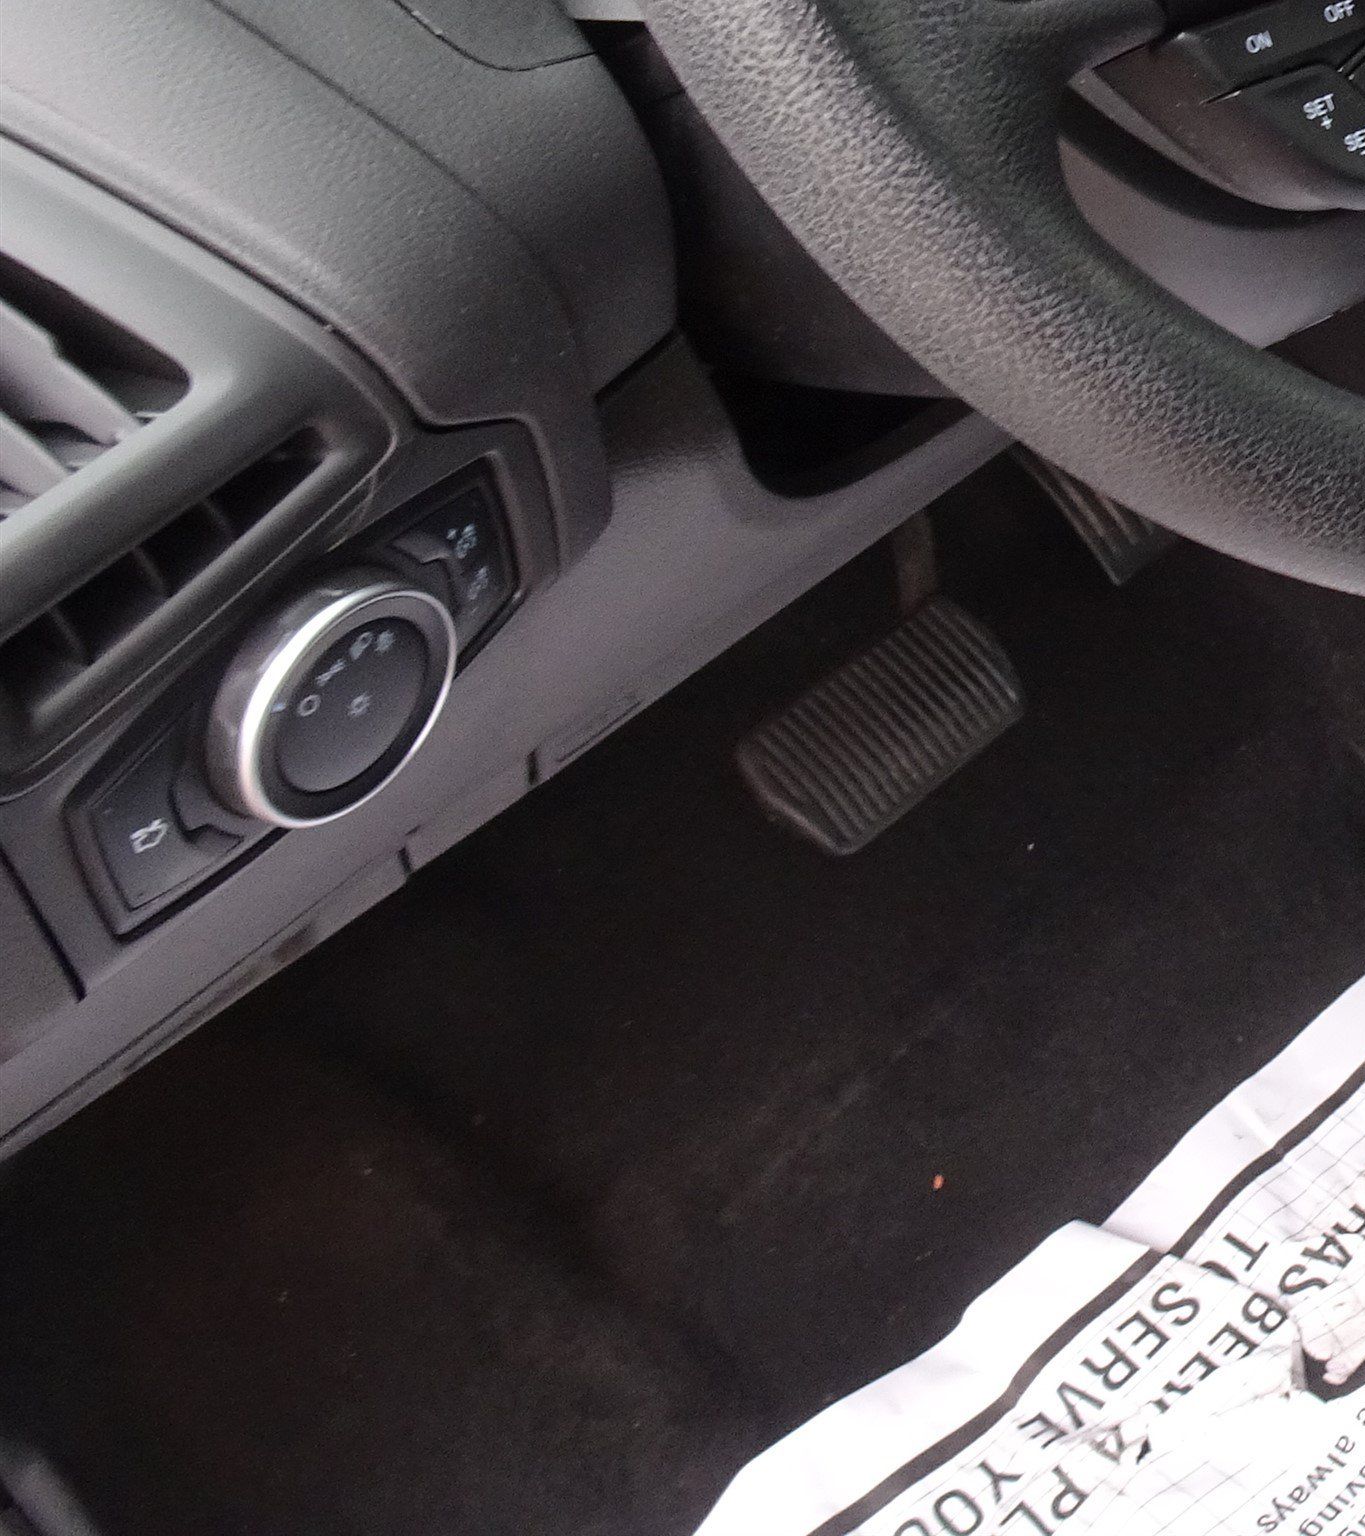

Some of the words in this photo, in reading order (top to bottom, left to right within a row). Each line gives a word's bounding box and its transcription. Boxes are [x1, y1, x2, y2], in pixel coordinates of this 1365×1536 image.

[1245, 30, 1273, 54] ON
[1302, 93, 1335, 120] SET
[1017, 1281, 1202, 1450] SERVE
[1255, 1434, 1355, 1534] always
